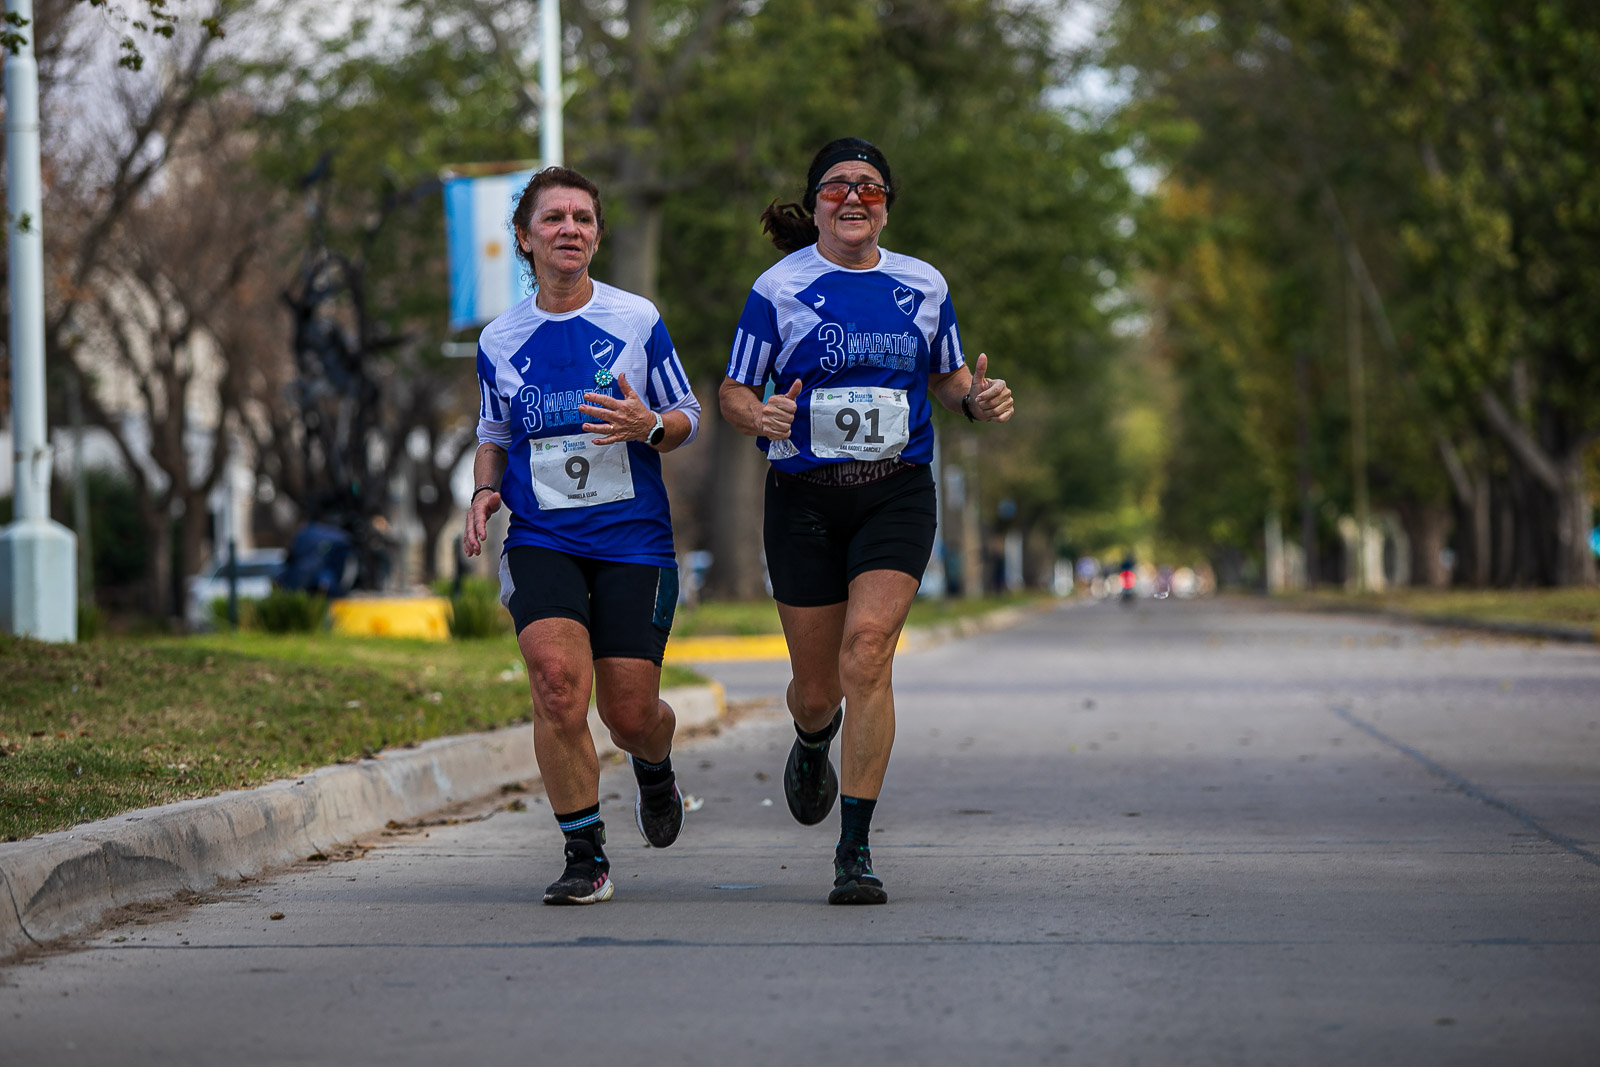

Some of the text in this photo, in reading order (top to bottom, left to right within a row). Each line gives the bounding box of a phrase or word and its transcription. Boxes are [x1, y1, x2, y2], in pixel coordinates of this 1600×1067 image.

[818, 322, 918, 374] 3 MARATÓN
[520, 385, 543, 432] 3
[835, 407, 885, 444] 91
[564, 455, 590, 490] 9
